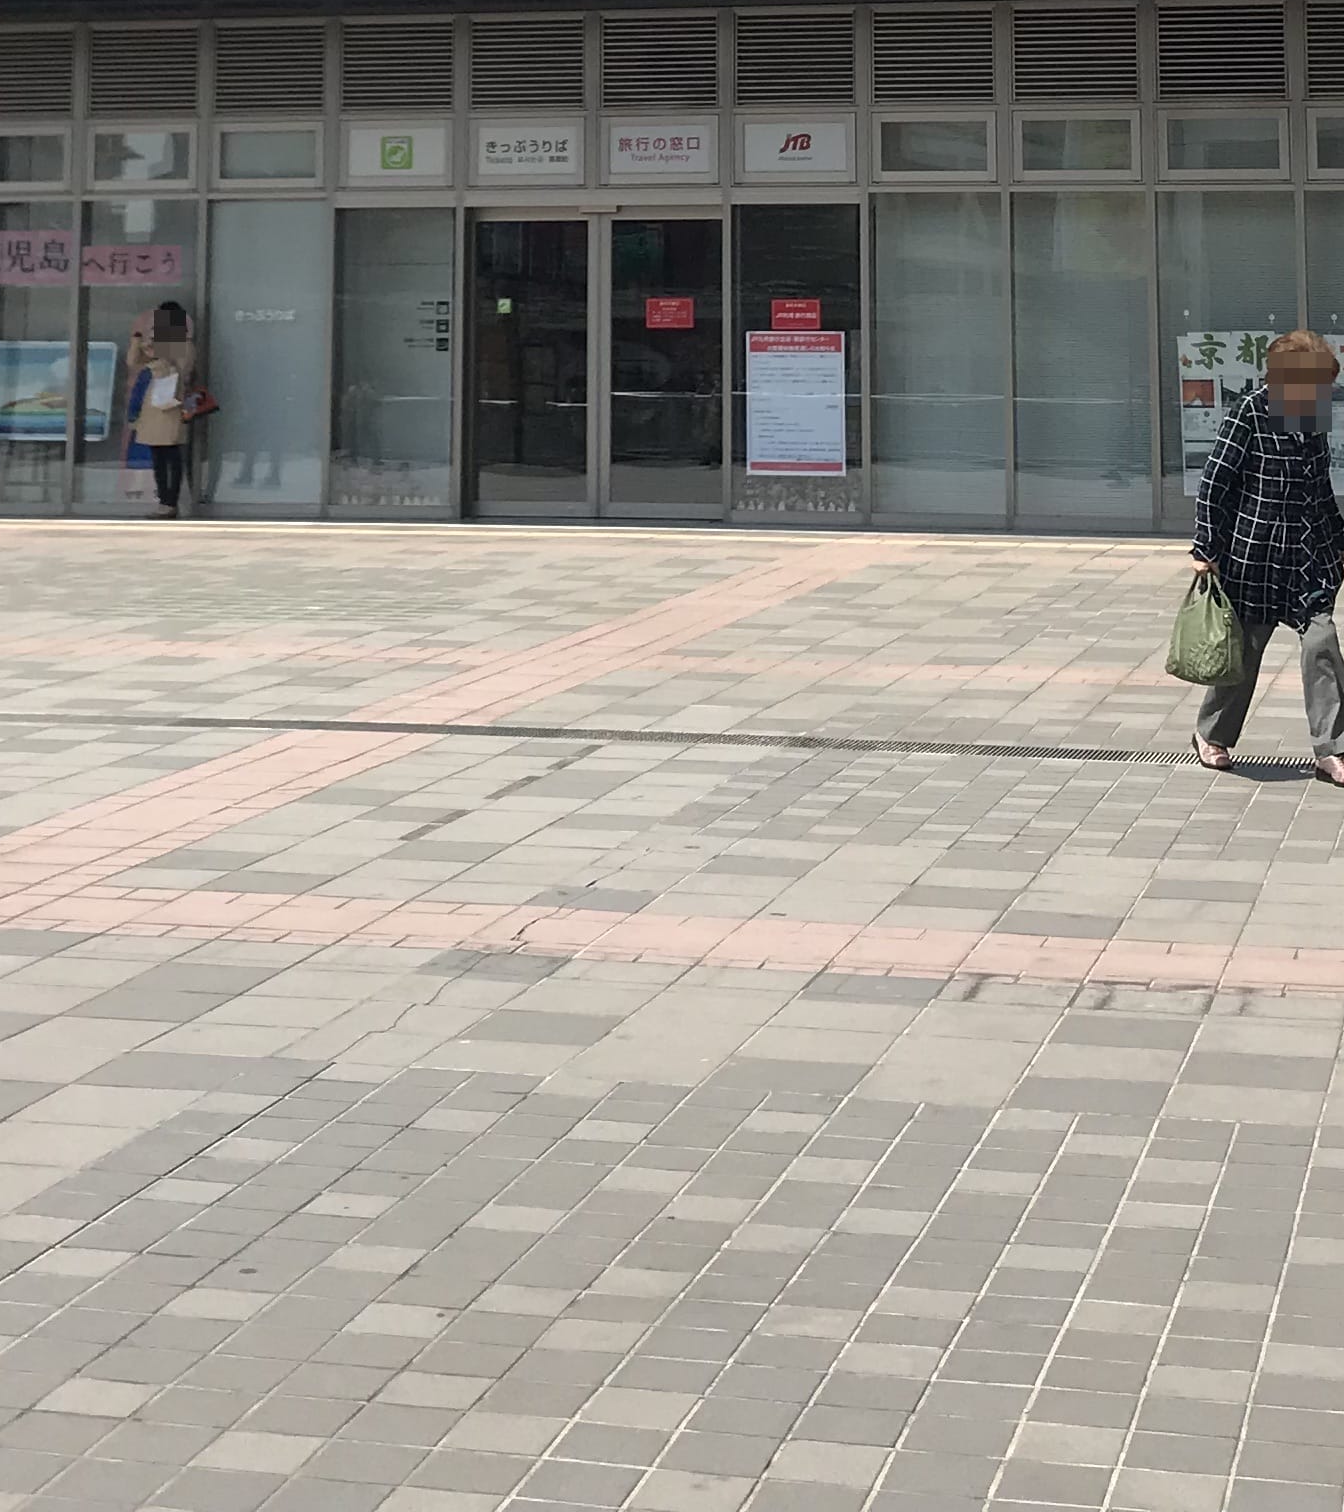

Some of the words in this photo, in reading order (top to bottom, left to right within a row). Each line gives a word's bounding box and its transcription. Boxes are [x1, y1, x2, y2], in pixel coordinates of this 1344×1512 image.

[485, 139, 569, 154] きっぷうりば
[618, 137, 701, 152] 旅行の窓口
[779, 133, 812, 154] JTB
[631, 154, 656, 162] Travel
[658, 154, 690, 164] Agency
[83, 252, 176, 275] へ行こう
[1191, 333, 1271, 371] 京都
